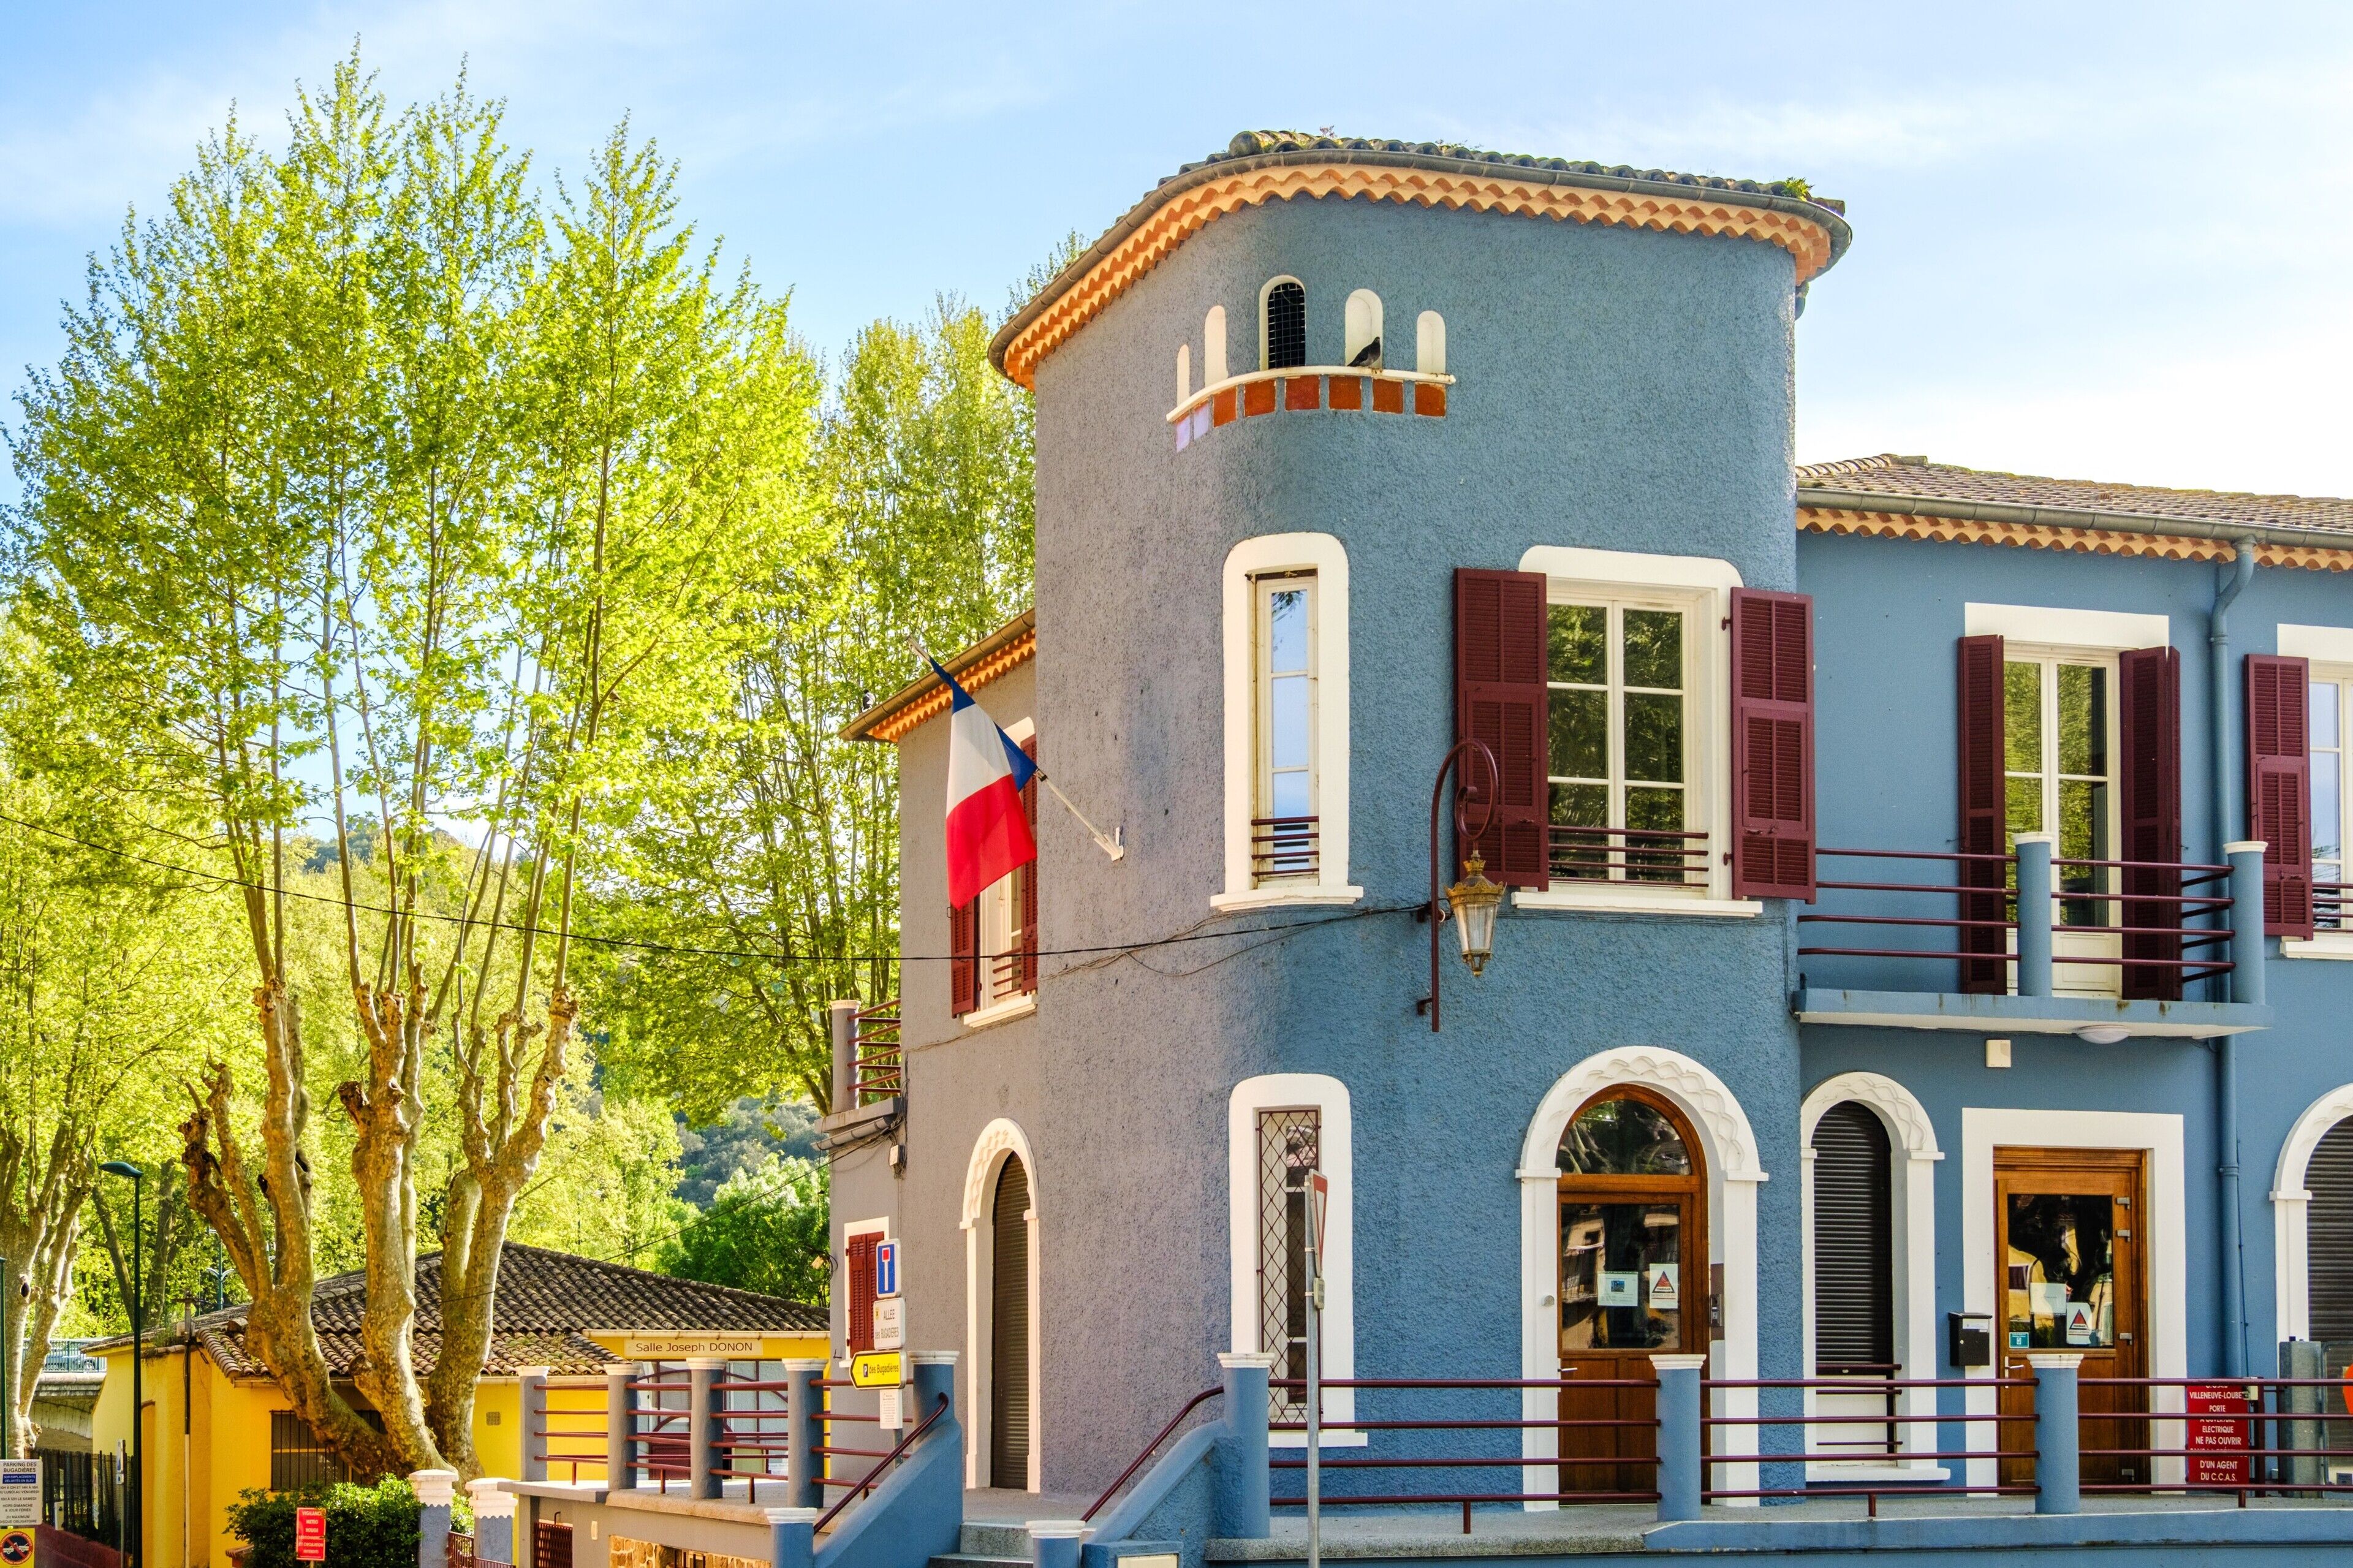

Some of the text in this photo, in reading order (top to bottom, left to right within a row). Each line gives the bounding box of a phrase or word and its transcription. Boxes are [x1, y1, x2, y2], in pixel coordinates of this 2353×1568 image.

[884, 1306, 895, 1320] ALLÉE
[636, 1343, 752, 1353] Salle Joseph DONON
[877, 1363, 899, 1376] Bugadières
[2205, 1436, 2216, 1445] PAS
[2216, 1461, 2238, 1469] AGENT
[2211, 1472, 2237, 1482] C.C.A.S.
